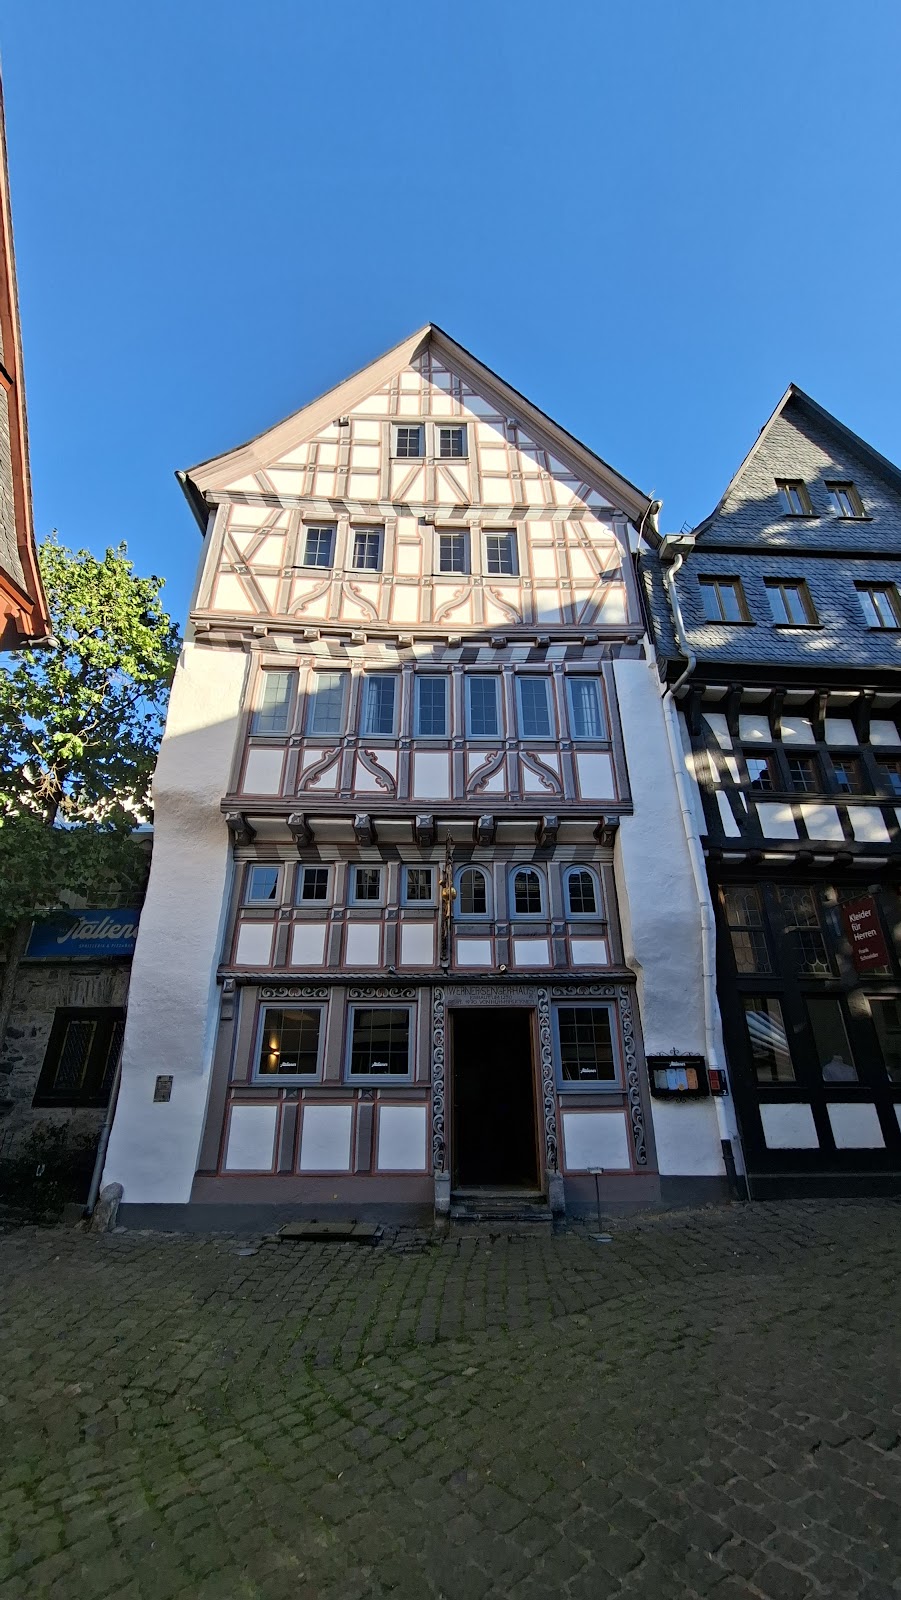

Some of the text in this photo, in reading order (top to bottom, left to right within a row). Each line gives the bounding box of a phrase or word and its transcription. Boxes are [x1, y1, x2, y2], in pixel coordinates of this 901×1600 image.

[849, 910, 871, 922] Kleider
[57, 916, 139, 944] Italien
[851, 923, 861, 931] für
[854, 929, 877, 941] Herren
